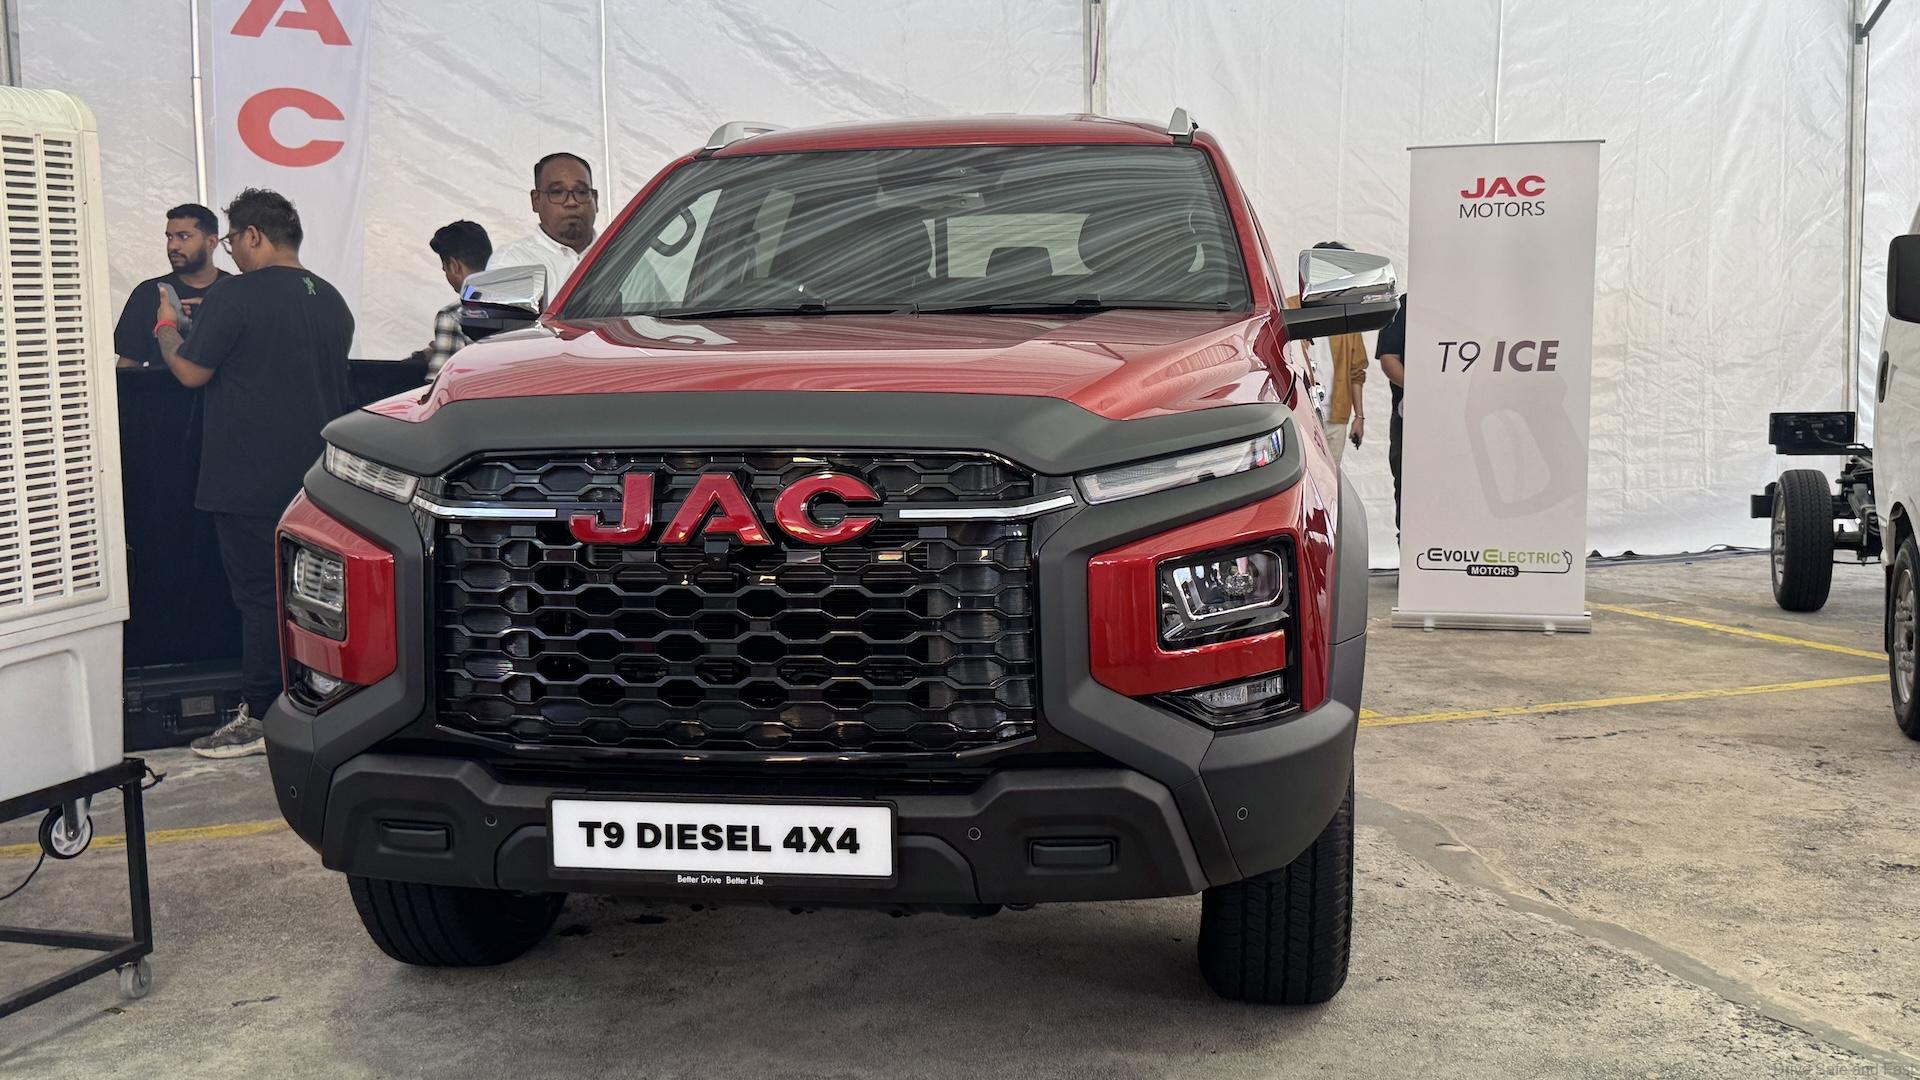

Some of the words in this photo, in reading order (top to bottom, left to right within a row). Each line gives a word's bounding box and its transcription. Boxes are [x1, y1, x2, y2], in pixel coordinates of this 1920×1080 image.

[1460, 175, 1546, 199] JAC
[1459, 201, 1545, 219] MOTORS
[1438, 341, 1481, 373] T9
[1492, 340, 1560, 372] ICE
[568, 471, 881, 545] JAC
[1427, 547, 1480, 562] EVOLV
[1483, 548, 1561, 565] ELECTRIC
[1471, 566, 1515, 576] MOTORS
[578, 821, 625, 849] T9
[636, 822, 772, 852] DIESEL
[782, 826, 860, 854] 4X4
[677, 874, 699, 884] Better
[701, 875, 722, 884] Drive
[726, 876, 748, 885] Better
[750, 875, 764, 885] Life
